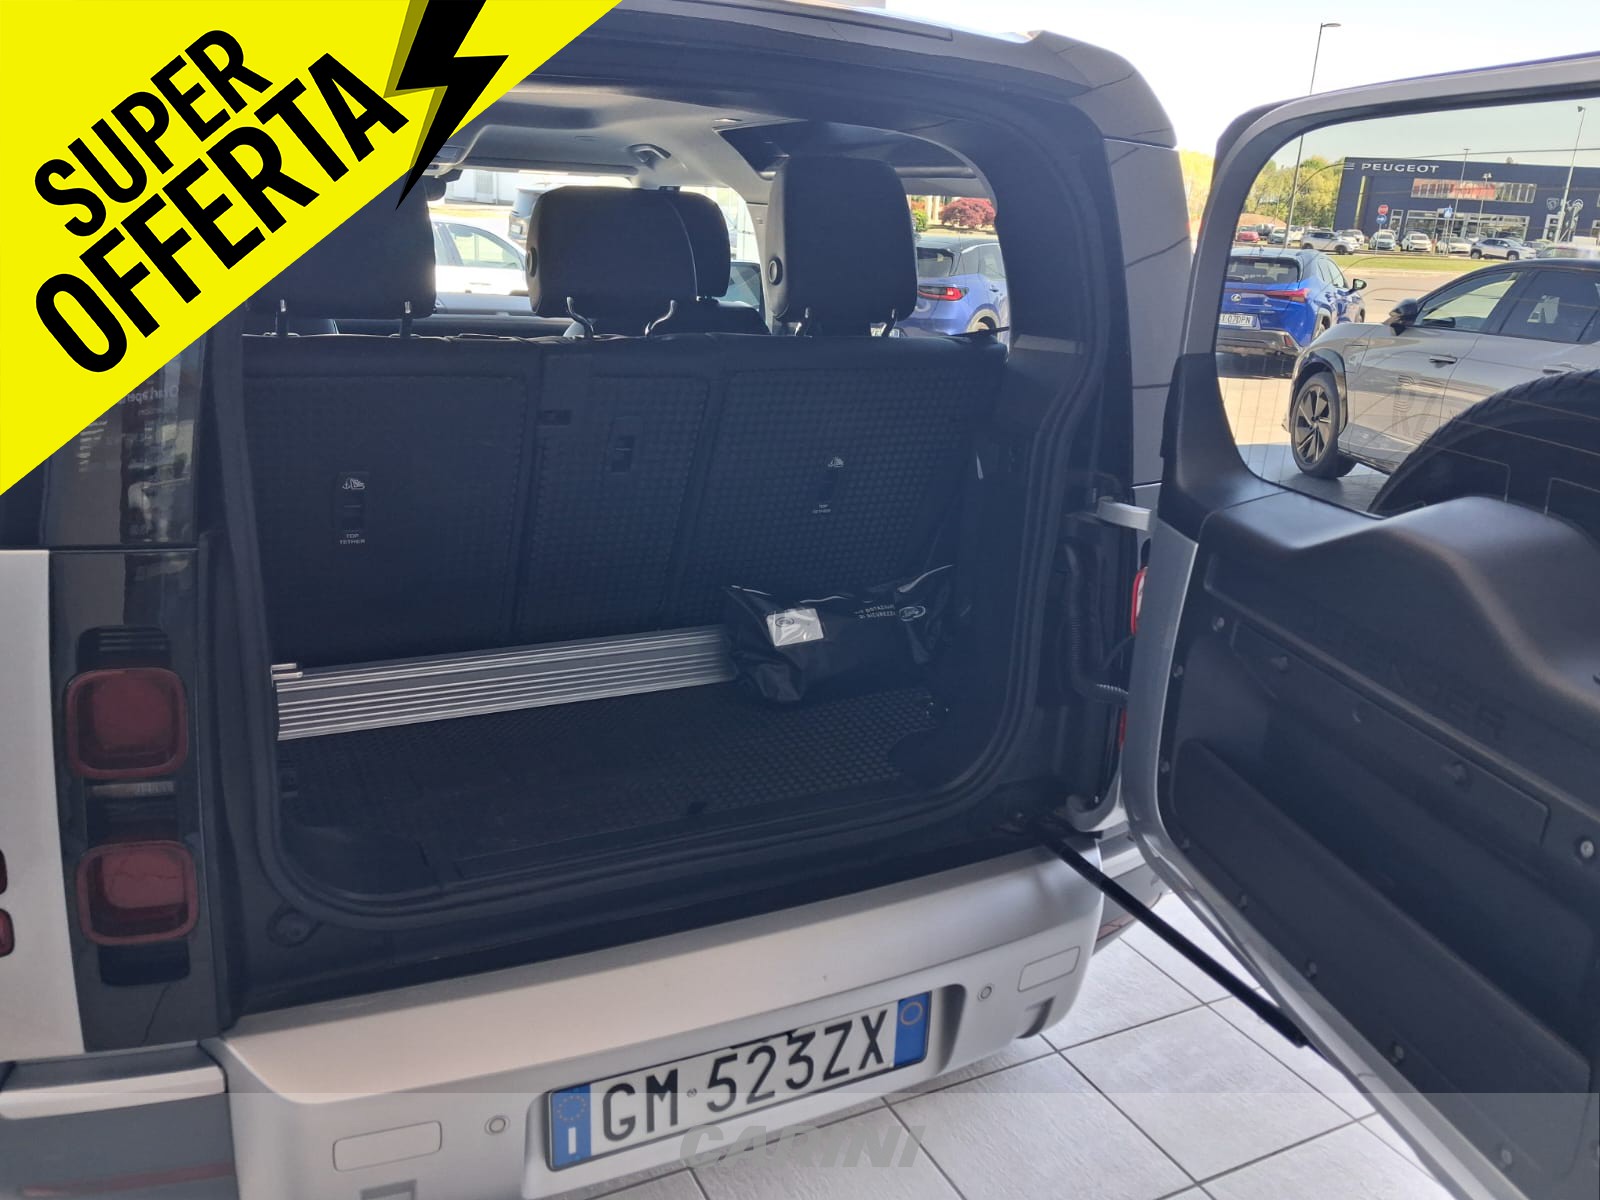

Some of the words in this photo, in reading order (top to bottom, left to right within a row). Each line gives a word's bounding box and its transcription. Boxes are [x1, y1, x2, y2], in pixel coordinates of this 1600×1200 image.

[1361, 163, 1440, 173] PEUGEOT
[603, 1068, 679, 1142] GM
[706, 1010, 888, 1112] 523ZX
